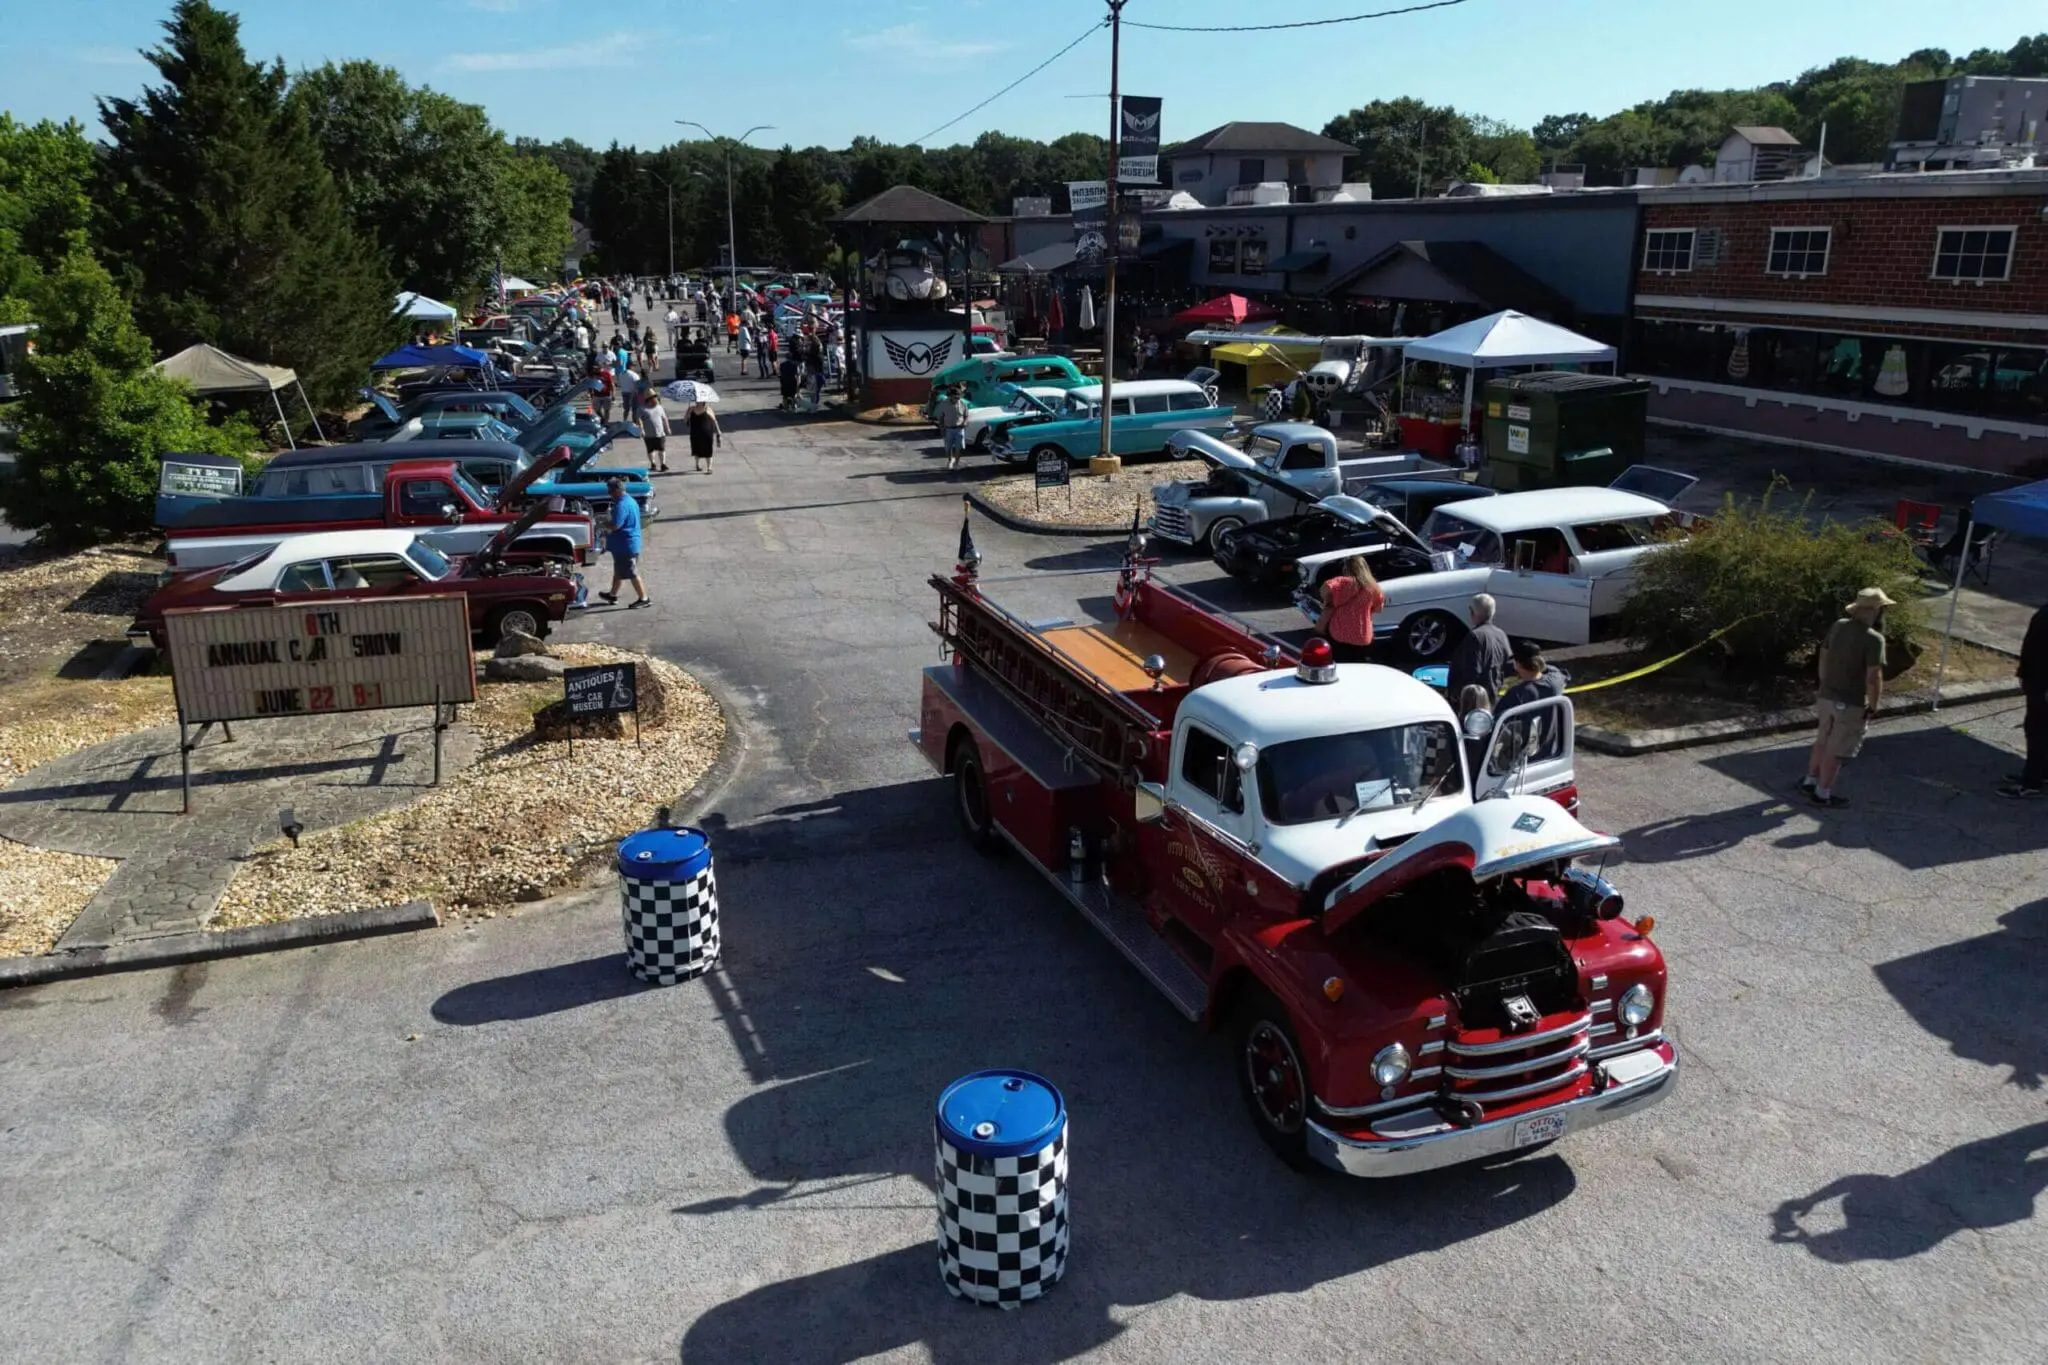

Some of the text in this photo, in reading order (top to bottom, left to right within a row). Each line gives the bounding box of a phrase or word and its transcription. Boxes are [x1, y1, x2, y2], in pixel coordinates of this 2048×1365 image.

[1119, 167, 1155, 177] MUSEUM
[1072, 187, 1106, 197] MUSEUM
[209, 639, 282, 667] ANNUAL
[352, 631, 402, 658] SHOW
[568, 671, 615, 692] ANTIQUES
[256, 688, 303, 713] JUNE
[309, 686, 336, 710] 22
[587, 692, 603, 701] CAR
[572, 701, 604, 712] MUSEUM
